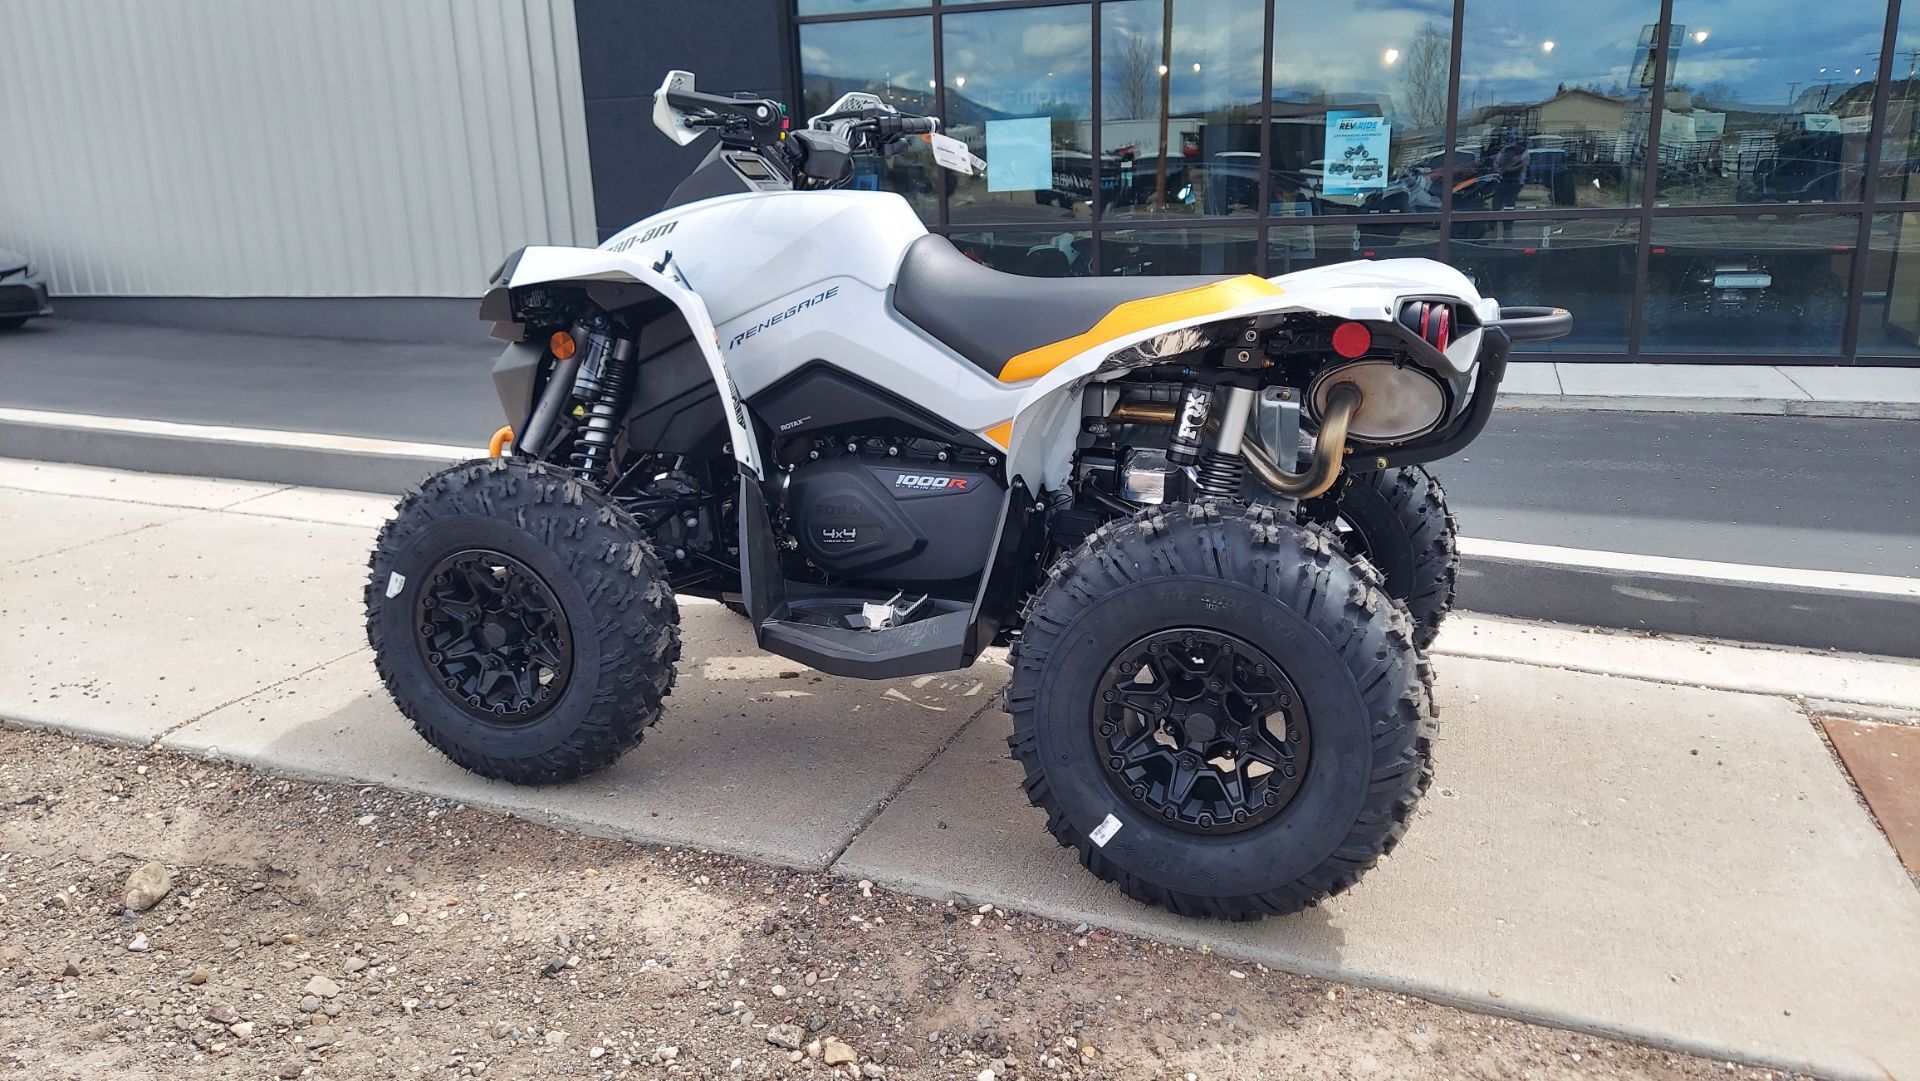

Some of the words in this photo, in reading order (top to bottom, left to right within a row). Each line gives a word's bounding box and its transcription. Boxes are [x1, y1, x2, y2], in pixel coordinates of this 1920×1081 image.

[729, 286, 840, 350] RENEGADE
[1178, 392, 1209, 440] FOX
[780, 419, 804, 431] ROTAX
[896, 474, 968, 489] 1000R
[822, 528, 857, 539] 4x4
